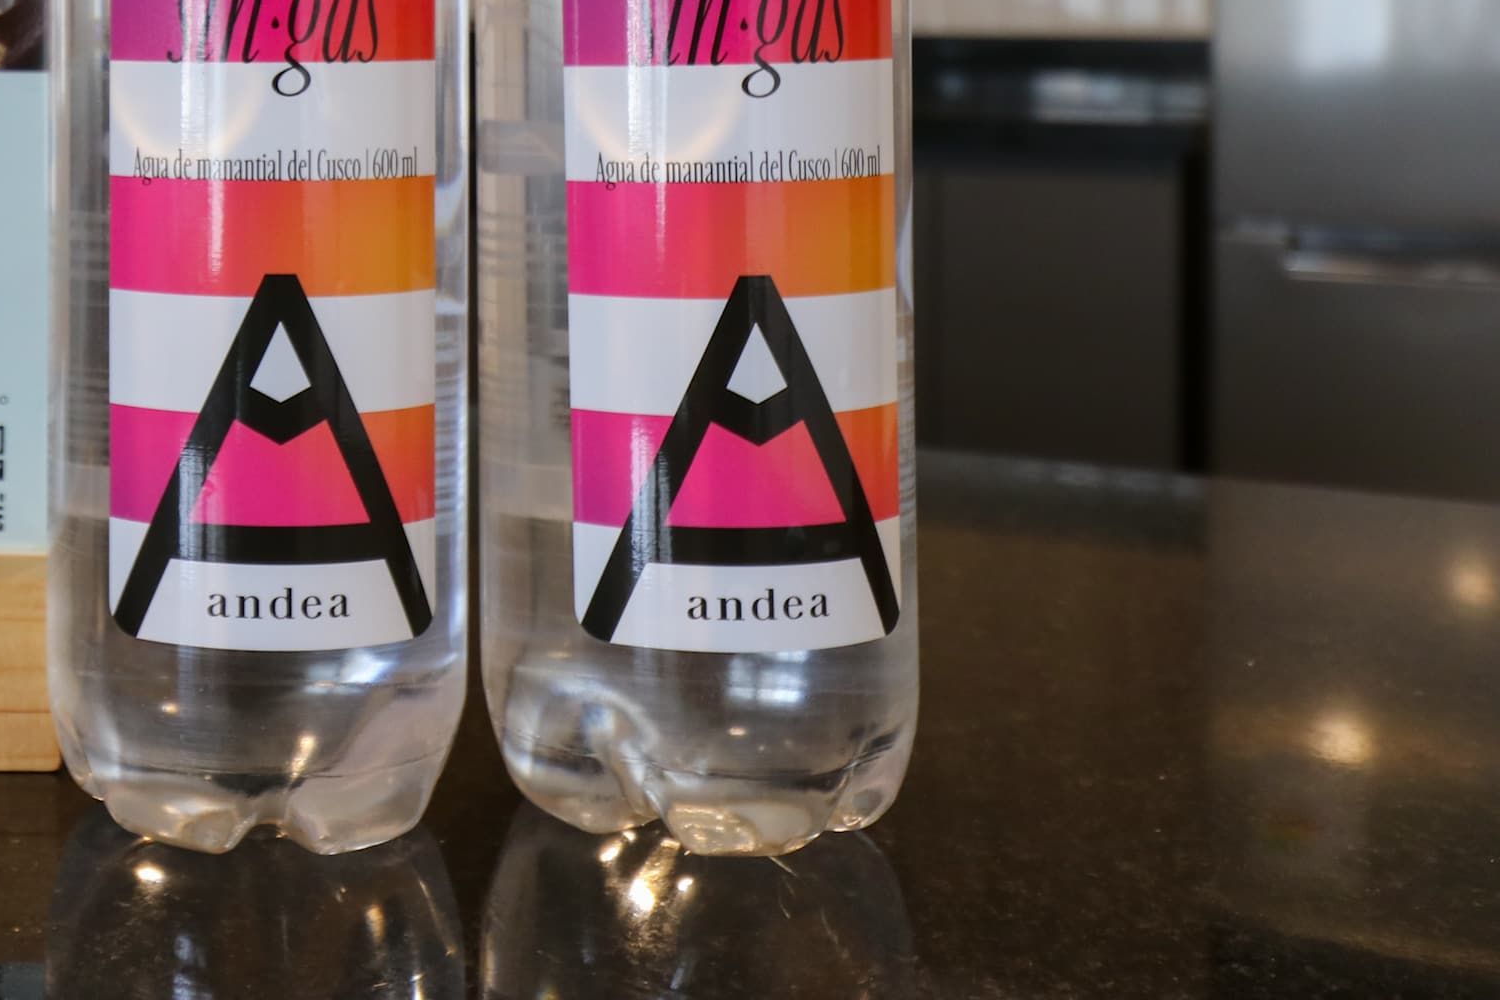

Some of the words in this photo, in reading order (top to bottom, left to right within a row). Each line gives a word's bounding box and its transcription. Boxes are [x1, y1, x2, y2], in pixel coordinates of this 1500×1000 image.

[133, 147, 169, 185] Agua
[173, 148, 192, 180] de
[198, 149, 283, 182] manantial
[287, 149, 312, 182] del
[317, 149, 361, 181] Cusco
[373, 148, 399, 180] 600
[402, 146, 418, 178] ml
[596, 152, 635, 190] Agua
[640, 151, 660, 184] de
[666, 151, 754, 184] manantial
[760, 150, 783, 182] del
[788, 149, 831, 181] Cusco
[841, 147, 865, 178] 600
[868, 145, 881, 177] ml
[207, 587, 350, 620] andea
[686, 588, 830, 621] andea
